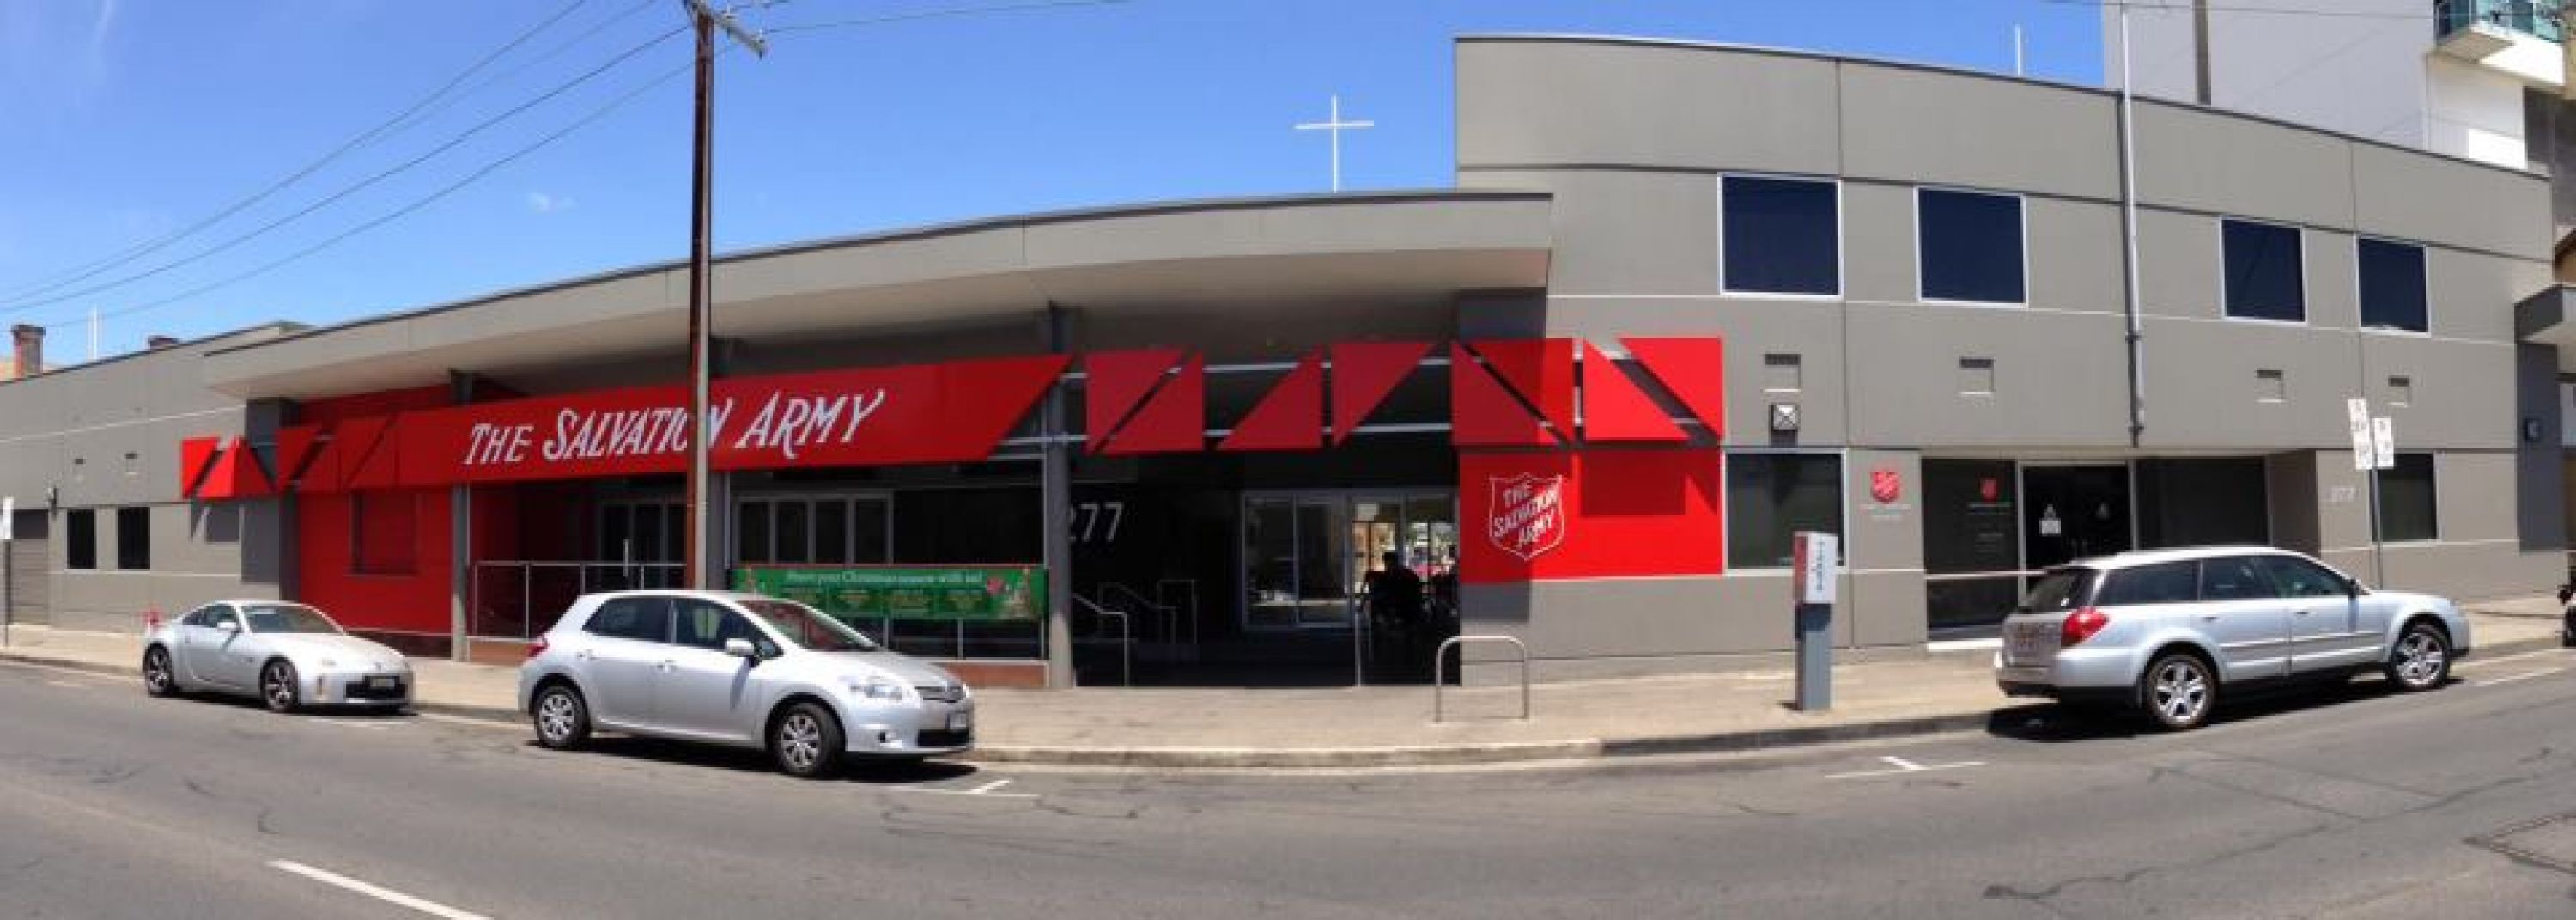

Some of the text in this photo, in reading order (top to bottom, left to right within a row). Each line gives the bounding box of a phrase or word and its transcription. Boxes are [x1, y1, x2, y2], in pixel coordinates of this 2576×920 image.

[463, 423, 534, 465] THE
[733, 388, 885, 460] ARMY
[1493, 482, 1559, 537] SALVATION
[1502, 479, 1532, 508] THE
[1516, 507, 1555, 550] ARMY
